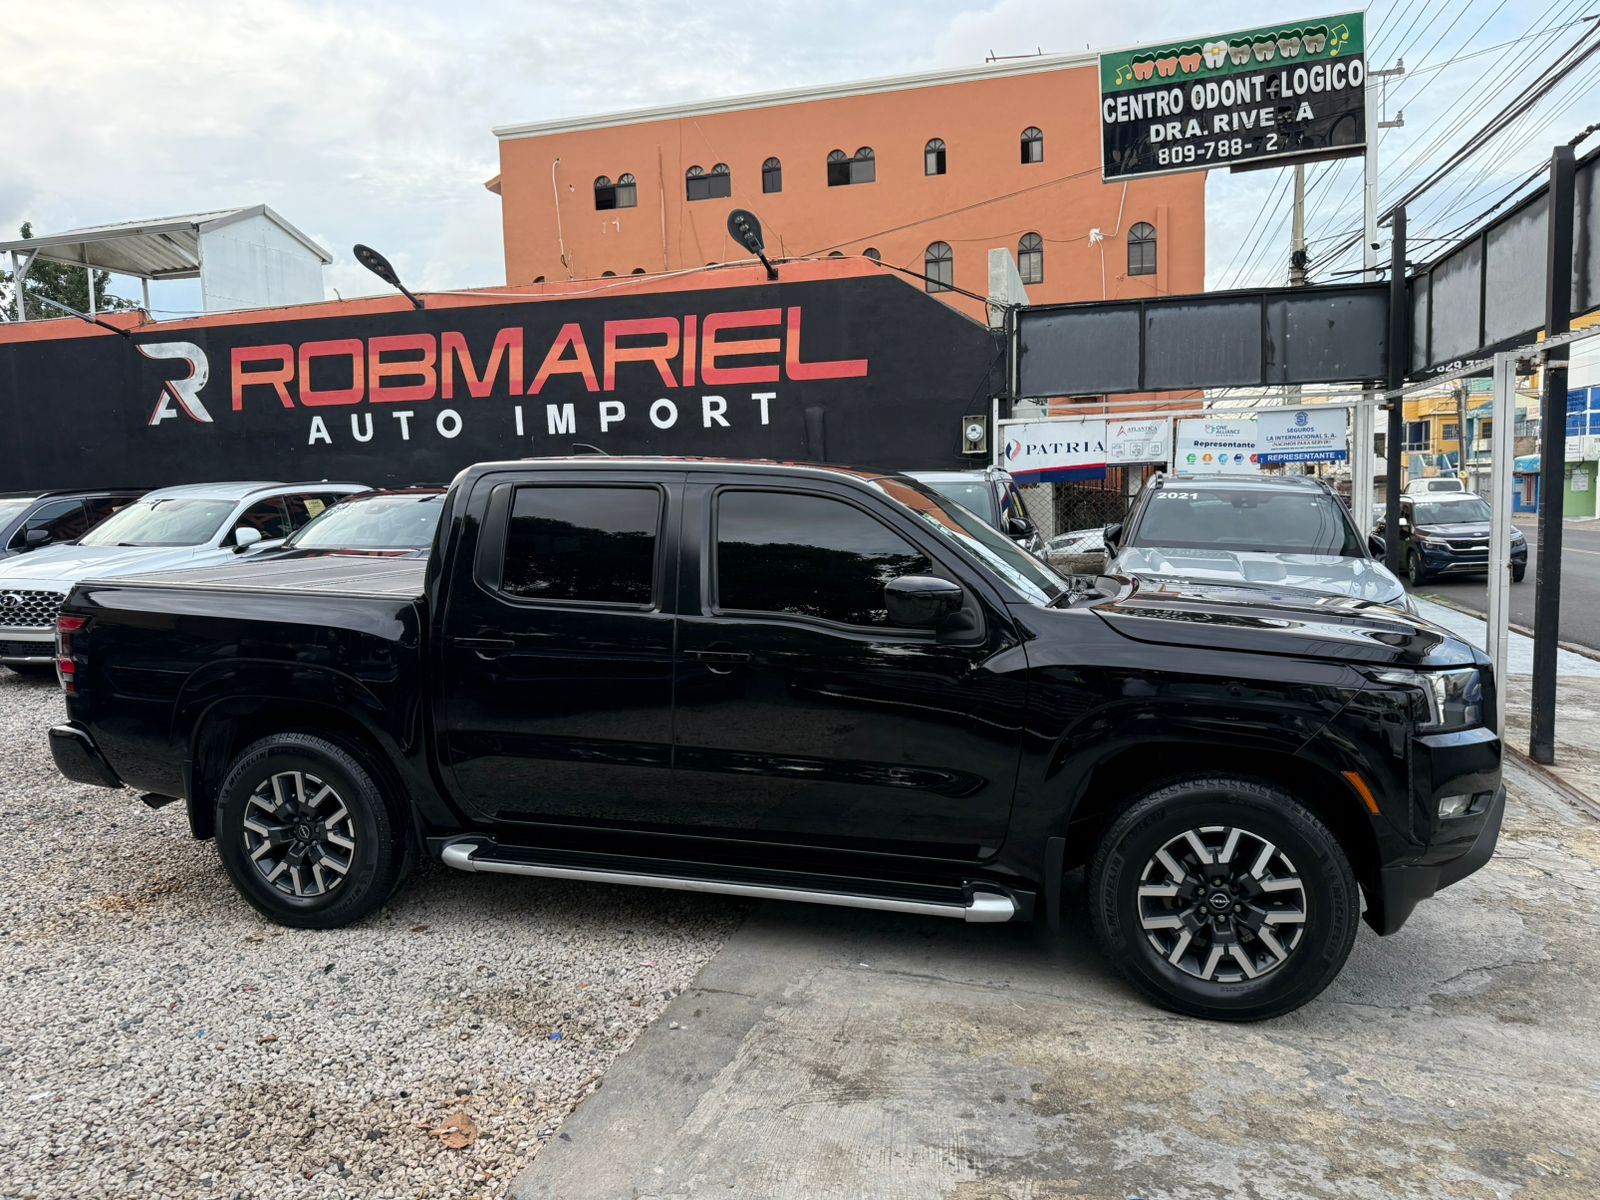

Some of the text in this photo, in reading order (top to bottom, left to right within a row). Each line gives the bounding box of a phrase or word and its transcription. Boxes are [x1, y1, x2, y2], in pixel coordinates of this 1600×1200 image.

[1103, 59, 1364, 124] CENTRO ODONTLOGICO
[1150, 101, 1315, 144] DRA. RIVEA
[230, 306, 869, 411] ROBMARIEL
[307, 391, 778, 445] AUTO IMPORT
[1026, 441, 1104, 456] PATRIA
[1193, 440, 1256, 448] Representante
[1275, 433, 1322, 441] INTERNACIONAL
[1267, 451, 1336, 462] REPRESENTANTE
[1156, 492, 1199, 500] 2021
[228, 750, 266, 787] MICHELIN
[1104, 855, 1123, 928] MICHELIN
